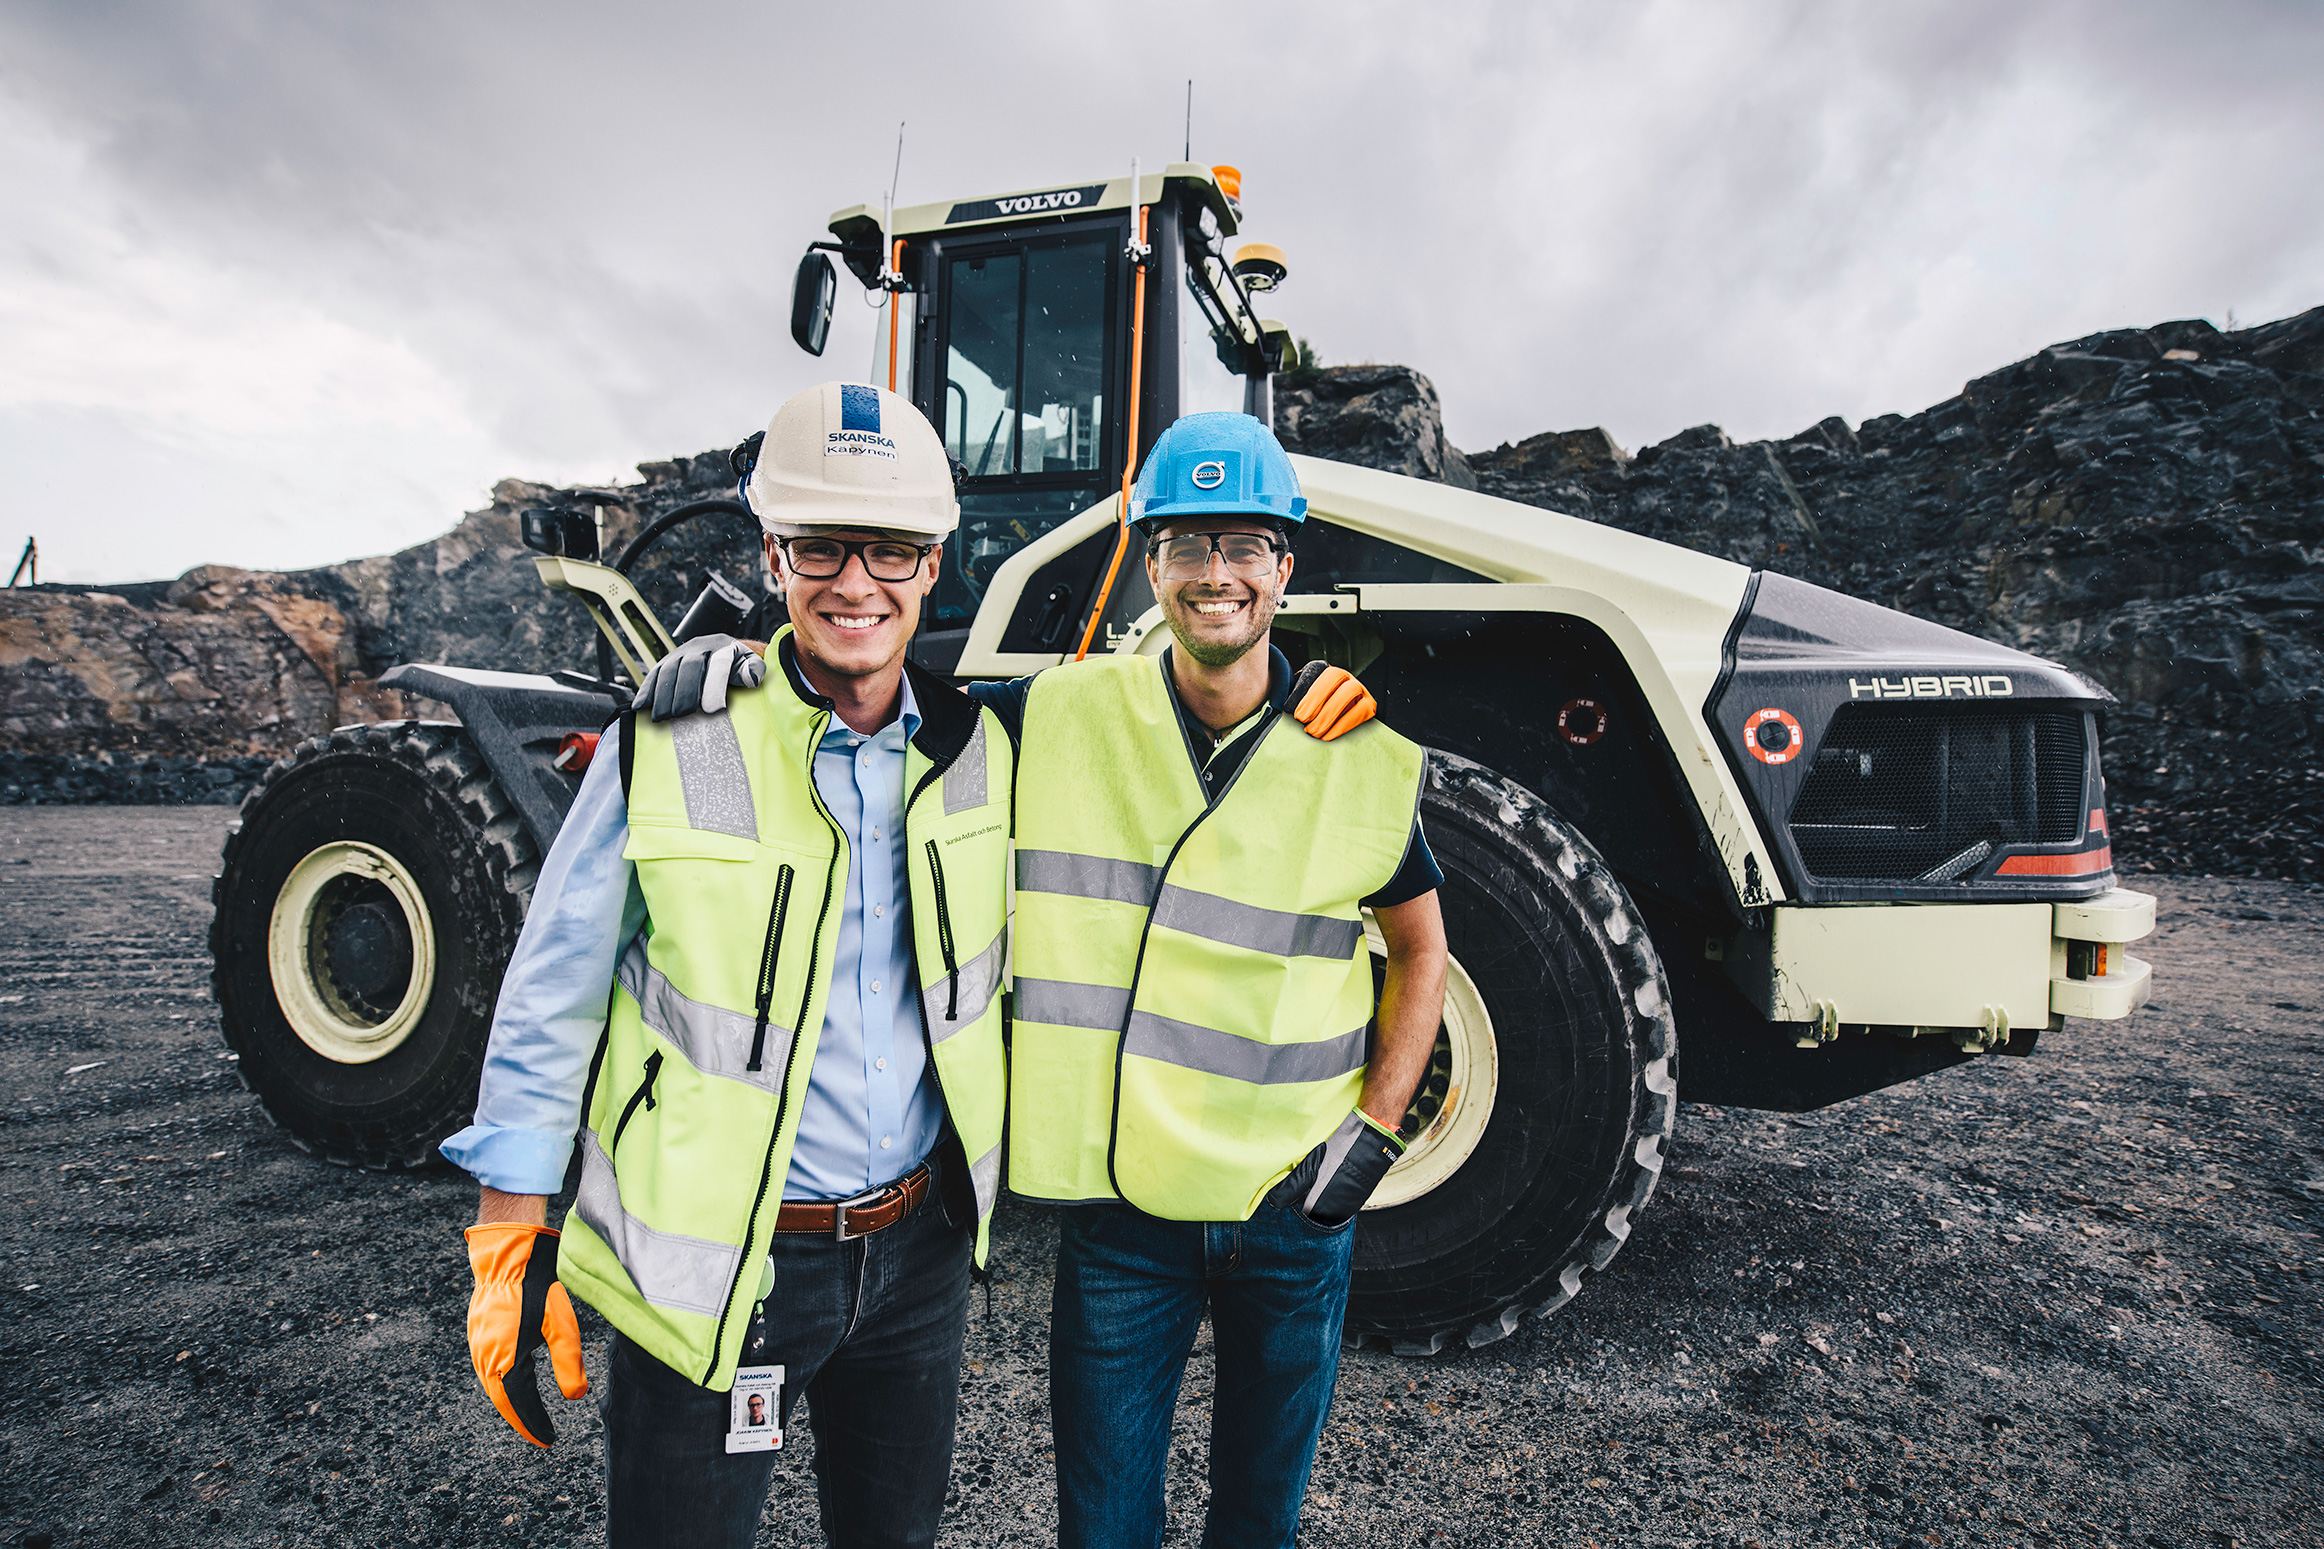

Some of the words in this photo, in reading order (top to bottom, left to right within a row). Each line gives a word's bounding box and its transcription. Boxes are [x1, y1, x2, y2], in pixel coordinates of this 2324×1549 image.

[994, 191, 1082, 214] VOLVO
[828, 433, 896, 449] SKANSKA
[1848, 675, 2014, 699] HYBRID
[739, 1373, 772, 1381] SKANSKA
